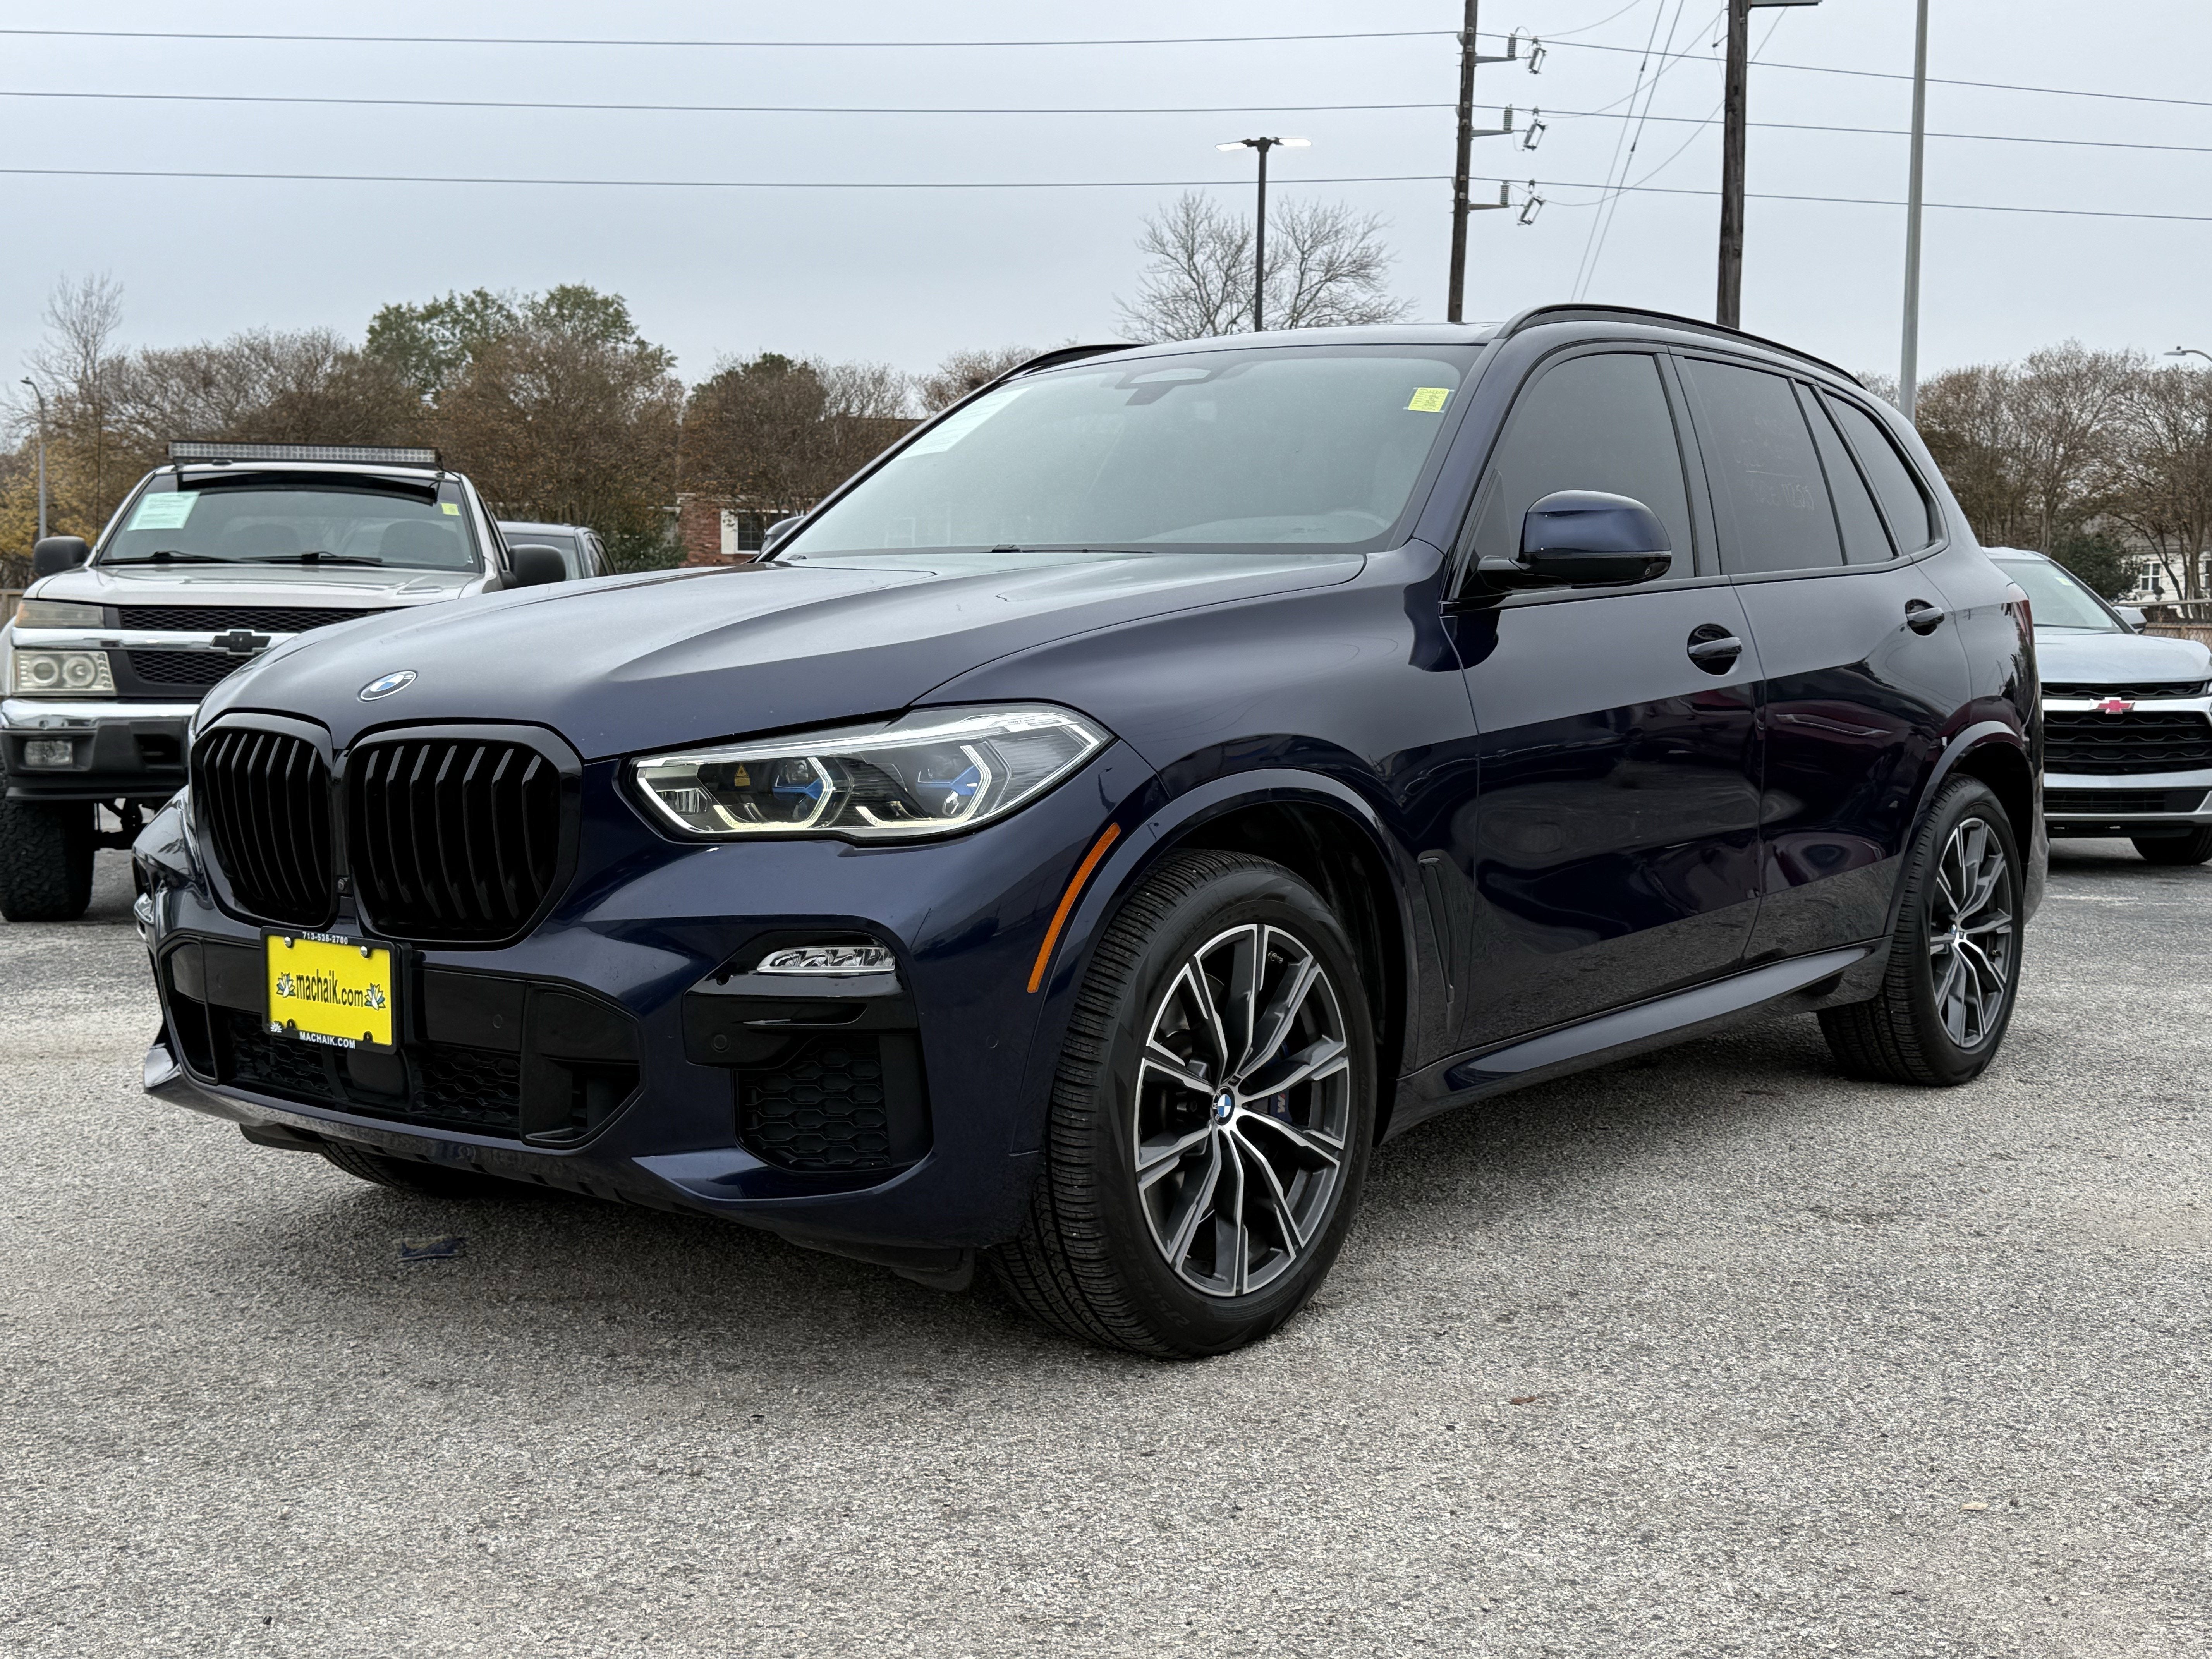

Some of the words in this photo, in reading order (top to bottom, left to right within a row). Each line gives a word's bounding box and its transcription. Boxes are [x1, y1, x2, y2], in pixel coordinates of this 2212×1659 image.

[302, 931, 348, 945] 713-538-2700
[296, 969, 363, 1007] machaik.com
[299, 1031, 356, 1049] MACHAIK.COM
[1212, 1090, 1222, 1121] BMW
